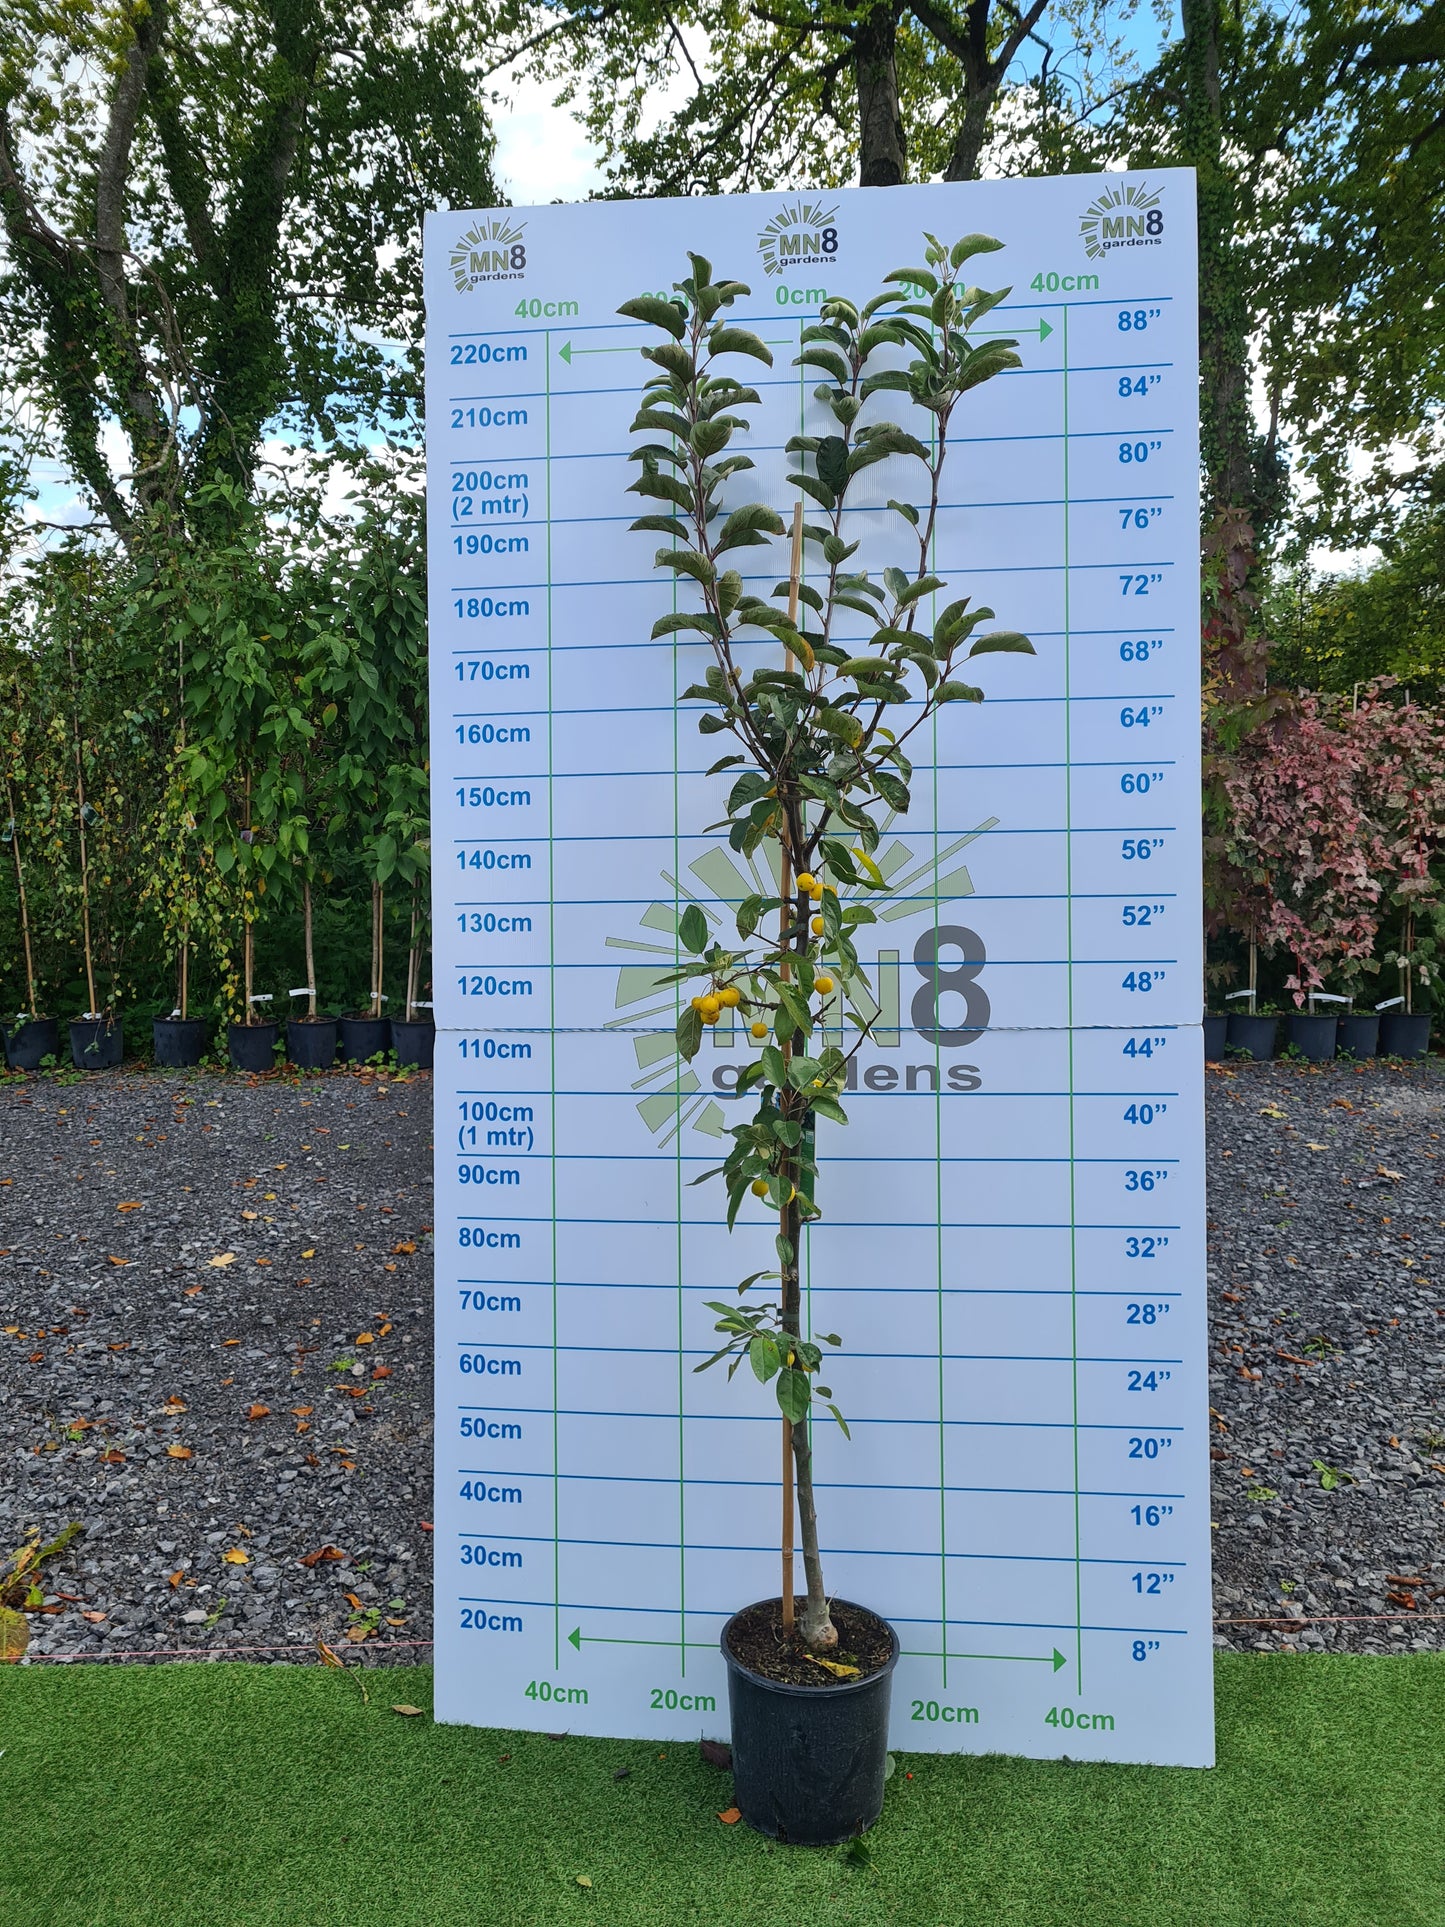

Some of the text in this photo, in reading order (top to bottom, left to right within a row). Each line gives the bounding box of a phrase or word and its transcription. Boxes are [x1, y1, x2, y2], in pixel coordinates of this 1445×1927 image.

[1102, 209, 1164, 240] MN8
[779, 227, 839, 257] MN8
[1102, 236, 1162, 250] gardens
[470, 244, 526, 273] MN8
[780, 254, 837, 268] gardens
[470, 270, 526, 284] gardens
[1030, 271, 1100, 294] 40cm
[775, 285, 828, 306] 0cm
[898, 280, 966, 300] 20m
[514, 297, 580, 319] 40cm
[1117, 308, 1161, 333] 88”
[450, 341, 528, 366] 220cm
[1117, 374, 1162, 399] 84”
[451, 405, 528, 429] 210cm
[1118, 440, 1162, 465] 80”
[450, 470, 528, 494] 200cm
[453, 494, 528, 520] (2 mtr)
[1118, 506, 1162, 531] 76”
[453, 532, 528, 556] 190cm
[1118, 573, 1163, 598] 72”
[453, 597, 529, 619] 180cm
[1119, 639, 1163, 664] 68”
[454, 660, 530, 682] 170cm
[1119, 705, 1163, 730] 64”
[454, 723, 531, 745] 160cm
[1120, 771, 1164, 795] 60”
[455, 786, 531, 808] 150cm
[456, 849, 532, 871] 140cm
[1121, 838, 1164, 862] 56”
[456, 912, 532, 934] 130cm
[1121, 903, 1165, 927] 52”
[457, 975, 533, 997] 120cm
[1121, 970, 1166, 993] 48”
[458, 1038, 532, 1060] 110cm
[1122, 1037, 1166, 1059] 44”
[711, 1055, 982, 1101] gens
[458, 1101, 534, 1122] 100cm
[1122, 1103, 1167, 1126] 40”
[458, 1125, 534, 1152] (1 mtr)
[457, 1163, 520, 1187] 90cm
[1124, 1169, 1168, 1193] 36”
[458, 1226, 521, 1249] 80cm
[1125, 1236, 1169, 1259] 32”
[457, 1289, 521, 1313] 70cm
[1126, 1303, 1170, 1326] 28”
[458, 1352, 522, 1376] 60cm
[1127, 1370, 1172, 1392] 24”
[458, 1416, 522, 1440] 50cm
[1127, 1437, 1172, 1460] 20”
[458, 1481, 522, 1504] 40cm
[1130, 1504, 1174, 1528] 16”
[459, 1544, 523, 1568] 30cm
[1130, 1572, 1175, 1595] 12”
[459, 1608, 523, 1633] 20cm
[1132, 1639, 1160, 1662] 8”
[524, 1681, 589, 1705] 40cm
[649, 1689, 717, 1713] 20cm
[911, 1700, 980, 1724] 20cm
[1043, 1707, 1116, 1732] 40cm
